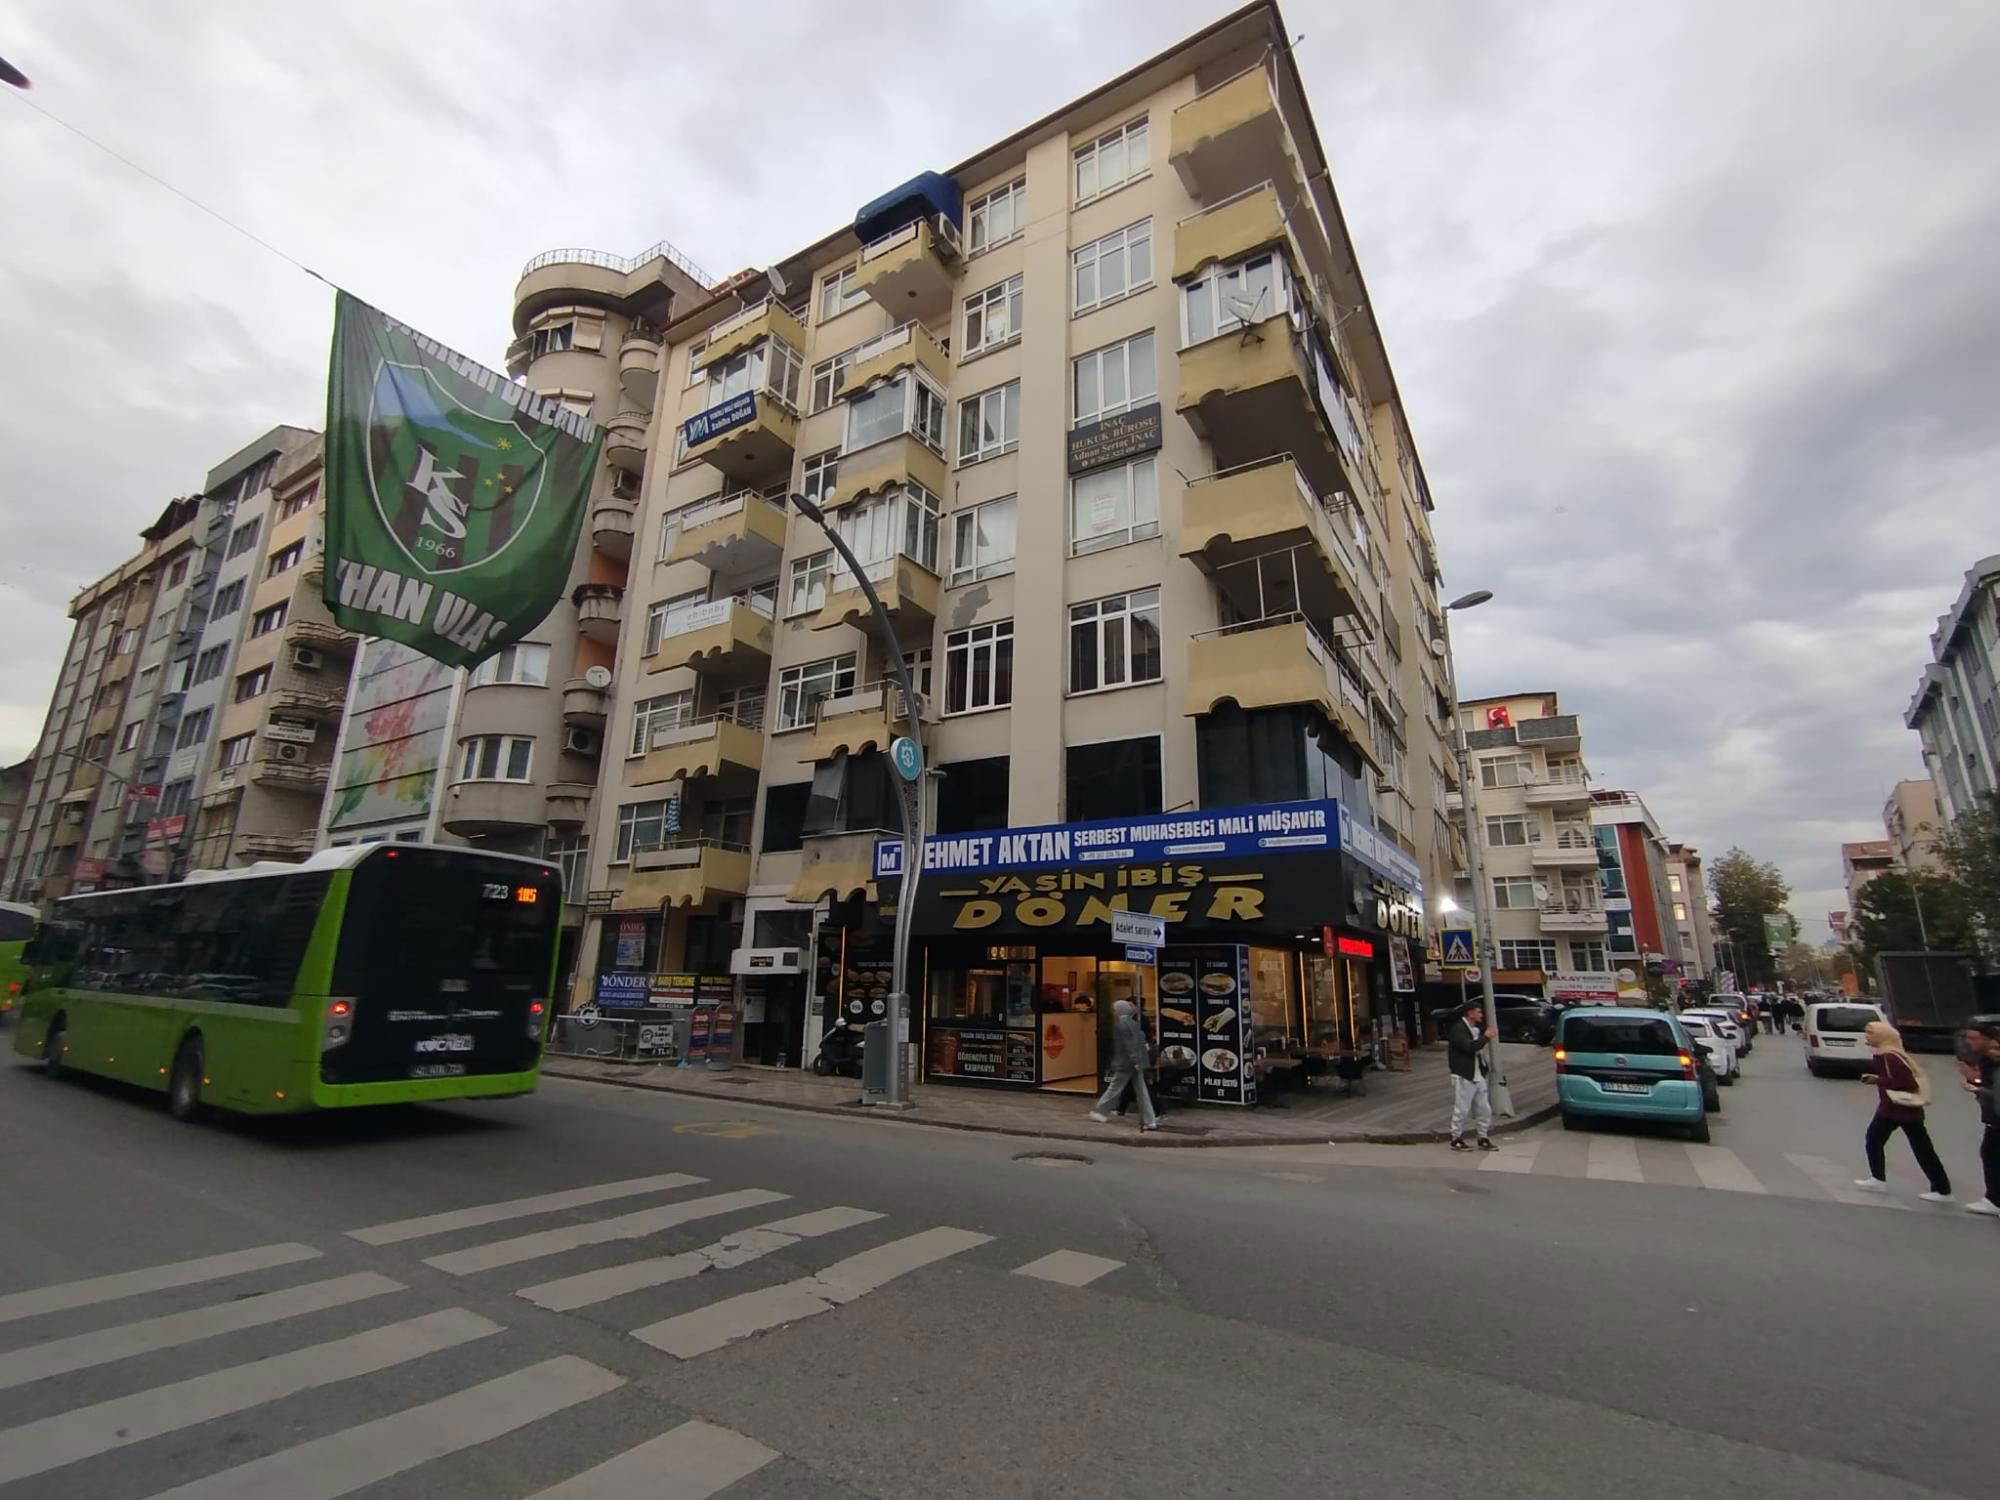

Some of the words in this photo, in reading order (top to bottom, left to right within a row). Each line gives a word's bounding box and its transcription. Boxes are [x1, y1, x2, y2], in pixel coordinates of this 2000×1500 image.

[1072, 433, 1108, 451] HUKUK
[1113, 415, 1156, 437] BÜROSU
[415, 536, 456, 559] 1966
[912, 837, 992, 870] EHMET
[998, 831, 1070, 864] AKTAN
[1074, 827, 1128, 847] SERBEST
[1131, 818, 1215, 842] MUHASEBECİ
[1219, 816, 1254, 836] MALİ
[1258, 809, 1327, 834] MÜŞAVİR
[481, 884, 509, 899] 723
[979, 869, 1105, 894] YASİN
[1117, 862, 1204, 888] İBİŞ
[953, 886, 1264, 929] DÖNER
[608, 974, 647, 988] ÖNDER
